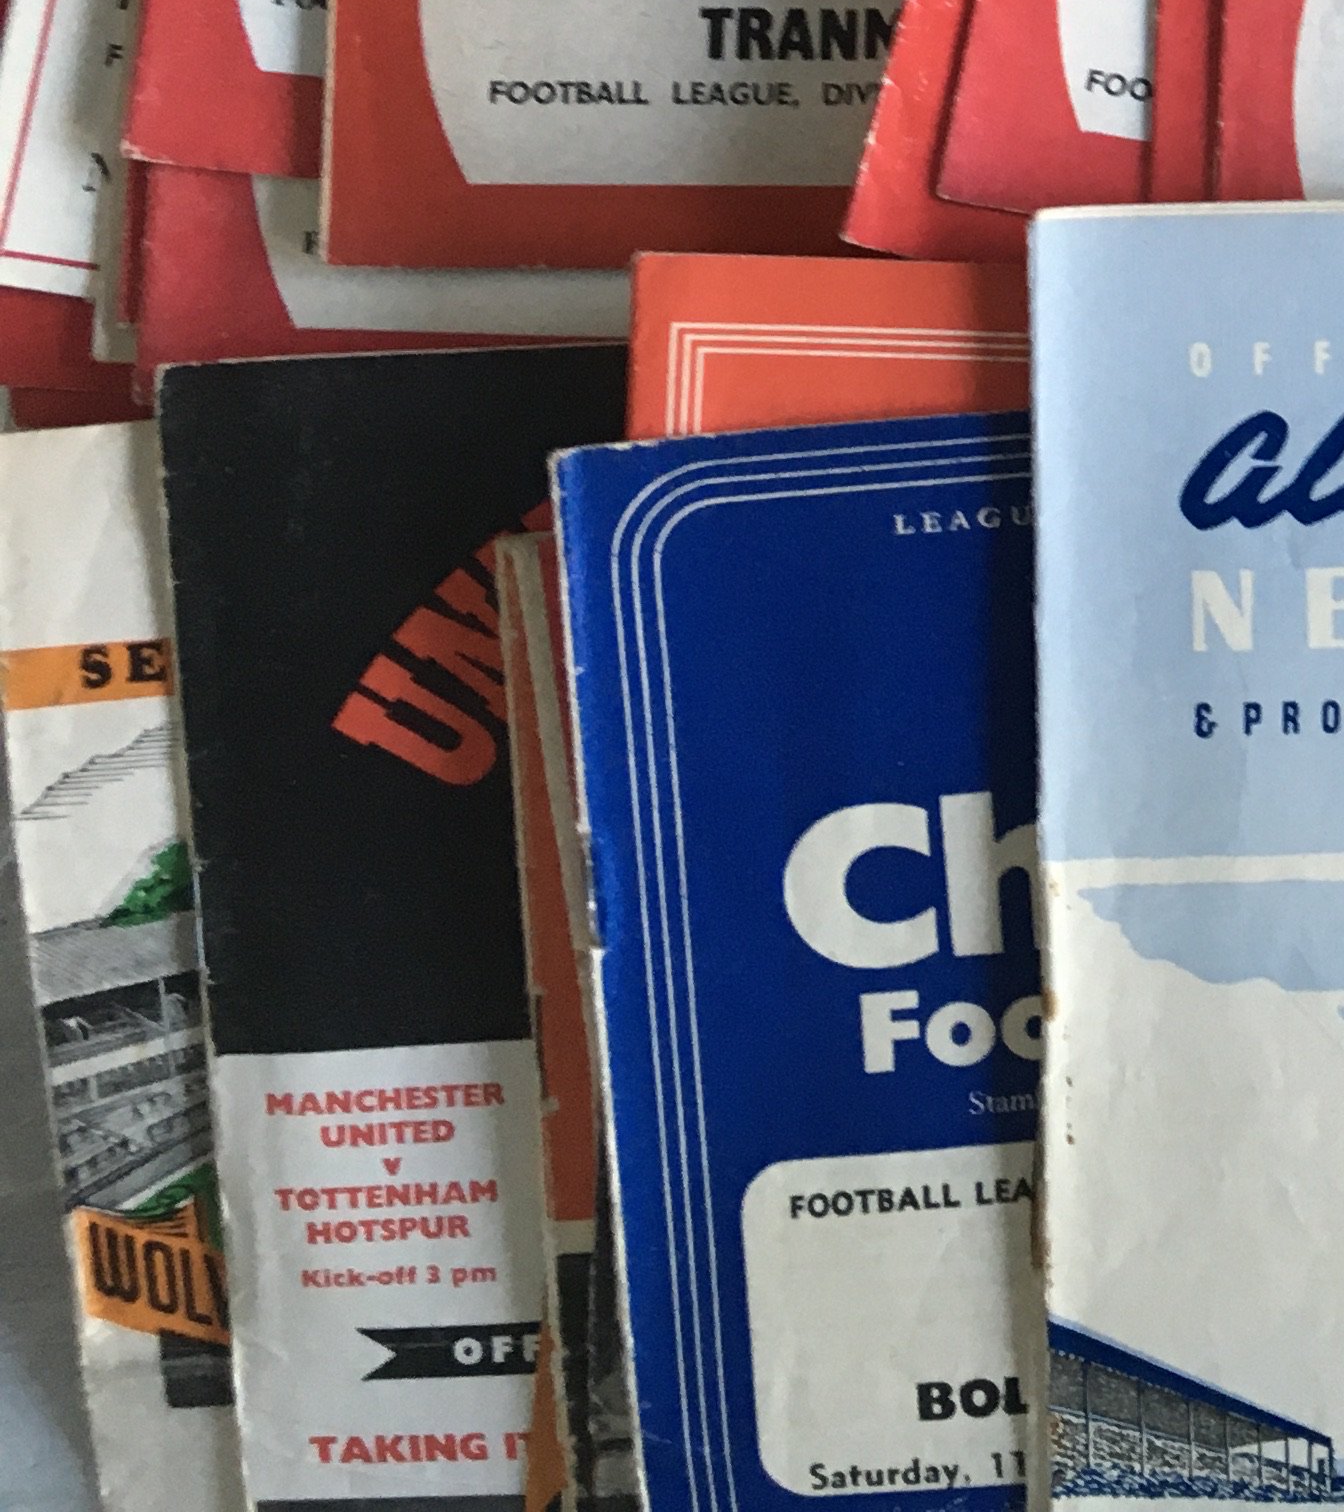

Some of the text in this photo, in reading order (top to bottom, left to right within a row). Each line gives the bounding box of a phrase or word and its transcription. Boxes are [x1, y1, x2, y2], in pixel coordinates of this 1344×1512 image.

[488, 80, 650, 106] FOOTBALL
[265, 1081, 506, 1116] MANCHESTER
[319, 1118, 456, 1149] UNITED
[274, 1178, 499, 1212] TOTTENHAM
[789, 1182, 962, 1220] FOOTBALL
[305, 1214, 471, 1245] HOTSPUR
[301, 1264, 498, 1288] Kick-off 3 pm
[308, 1431, 490, 1464] TAKING
